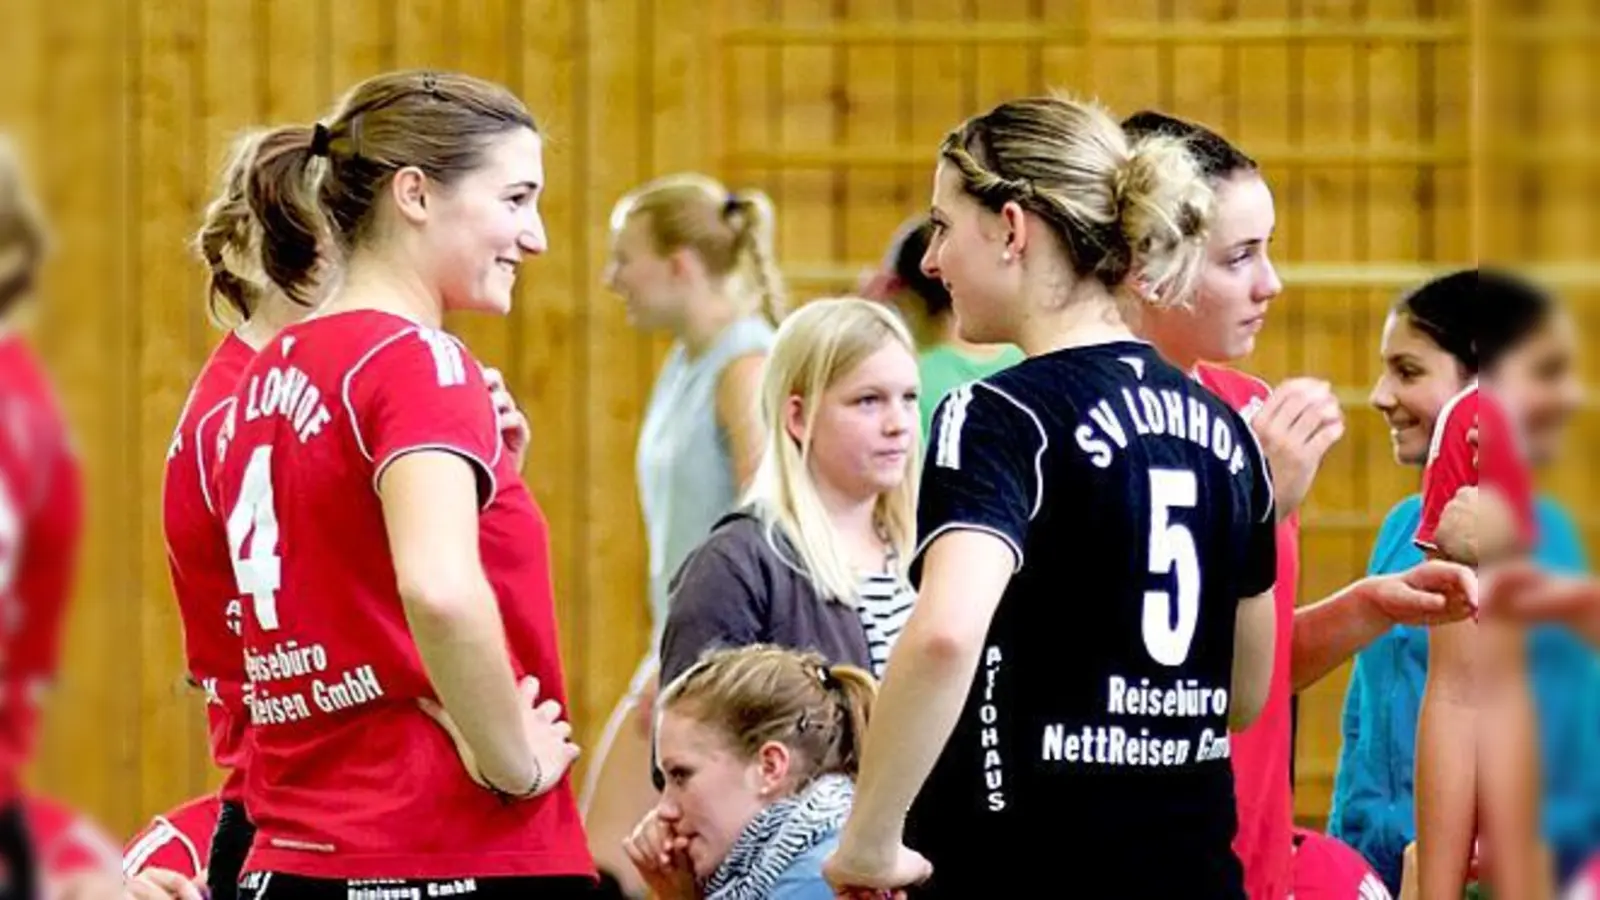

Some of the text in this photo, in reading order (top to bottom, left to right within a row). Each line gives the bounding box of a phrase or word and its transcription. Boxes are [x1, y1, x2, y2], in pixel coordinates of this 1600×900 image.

[1075, 399, 1128, 468] SV
[226, 444, 281, 631] 4
[1140, 468, 1201, 667] 5
[243, 640, 327, 682] eisebüro
[311, 664, 384, 714] GmbH
[1107, 675, 1228, 717] Reisebüro
[1042, 723, 1190, 767] NettReisen
